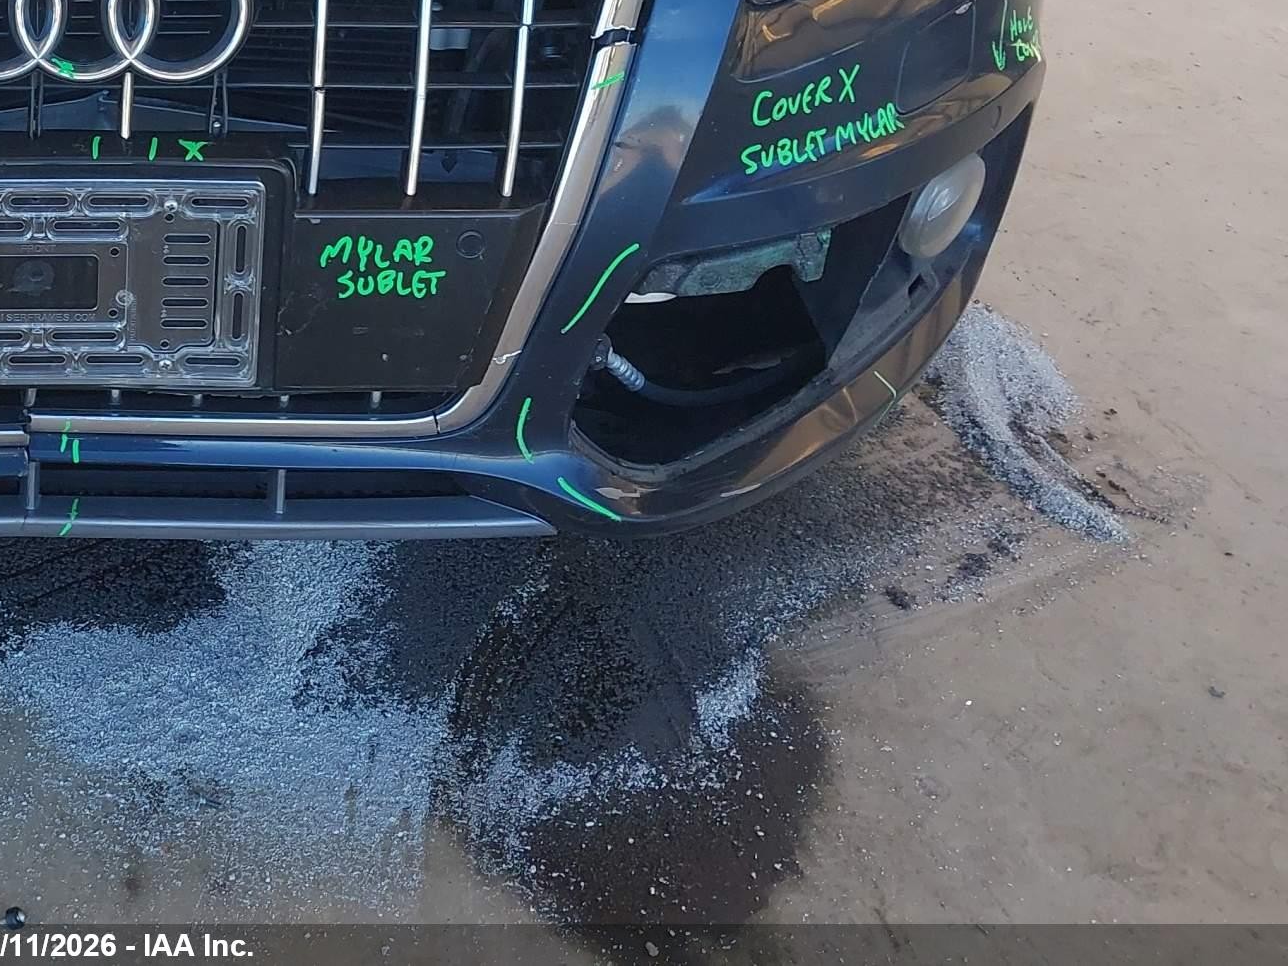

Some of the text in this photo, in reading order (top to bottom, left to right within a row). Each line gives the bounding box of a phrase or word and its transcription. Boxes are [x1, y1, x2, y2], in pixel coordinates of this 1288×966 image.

[751, 64, 861, 128] COVER X
[739, 101, 906, 175] SUBLET MYLAR
[318, 234, 435, 273] MYLAR
[335, 269, 448, 300] SUBLET
